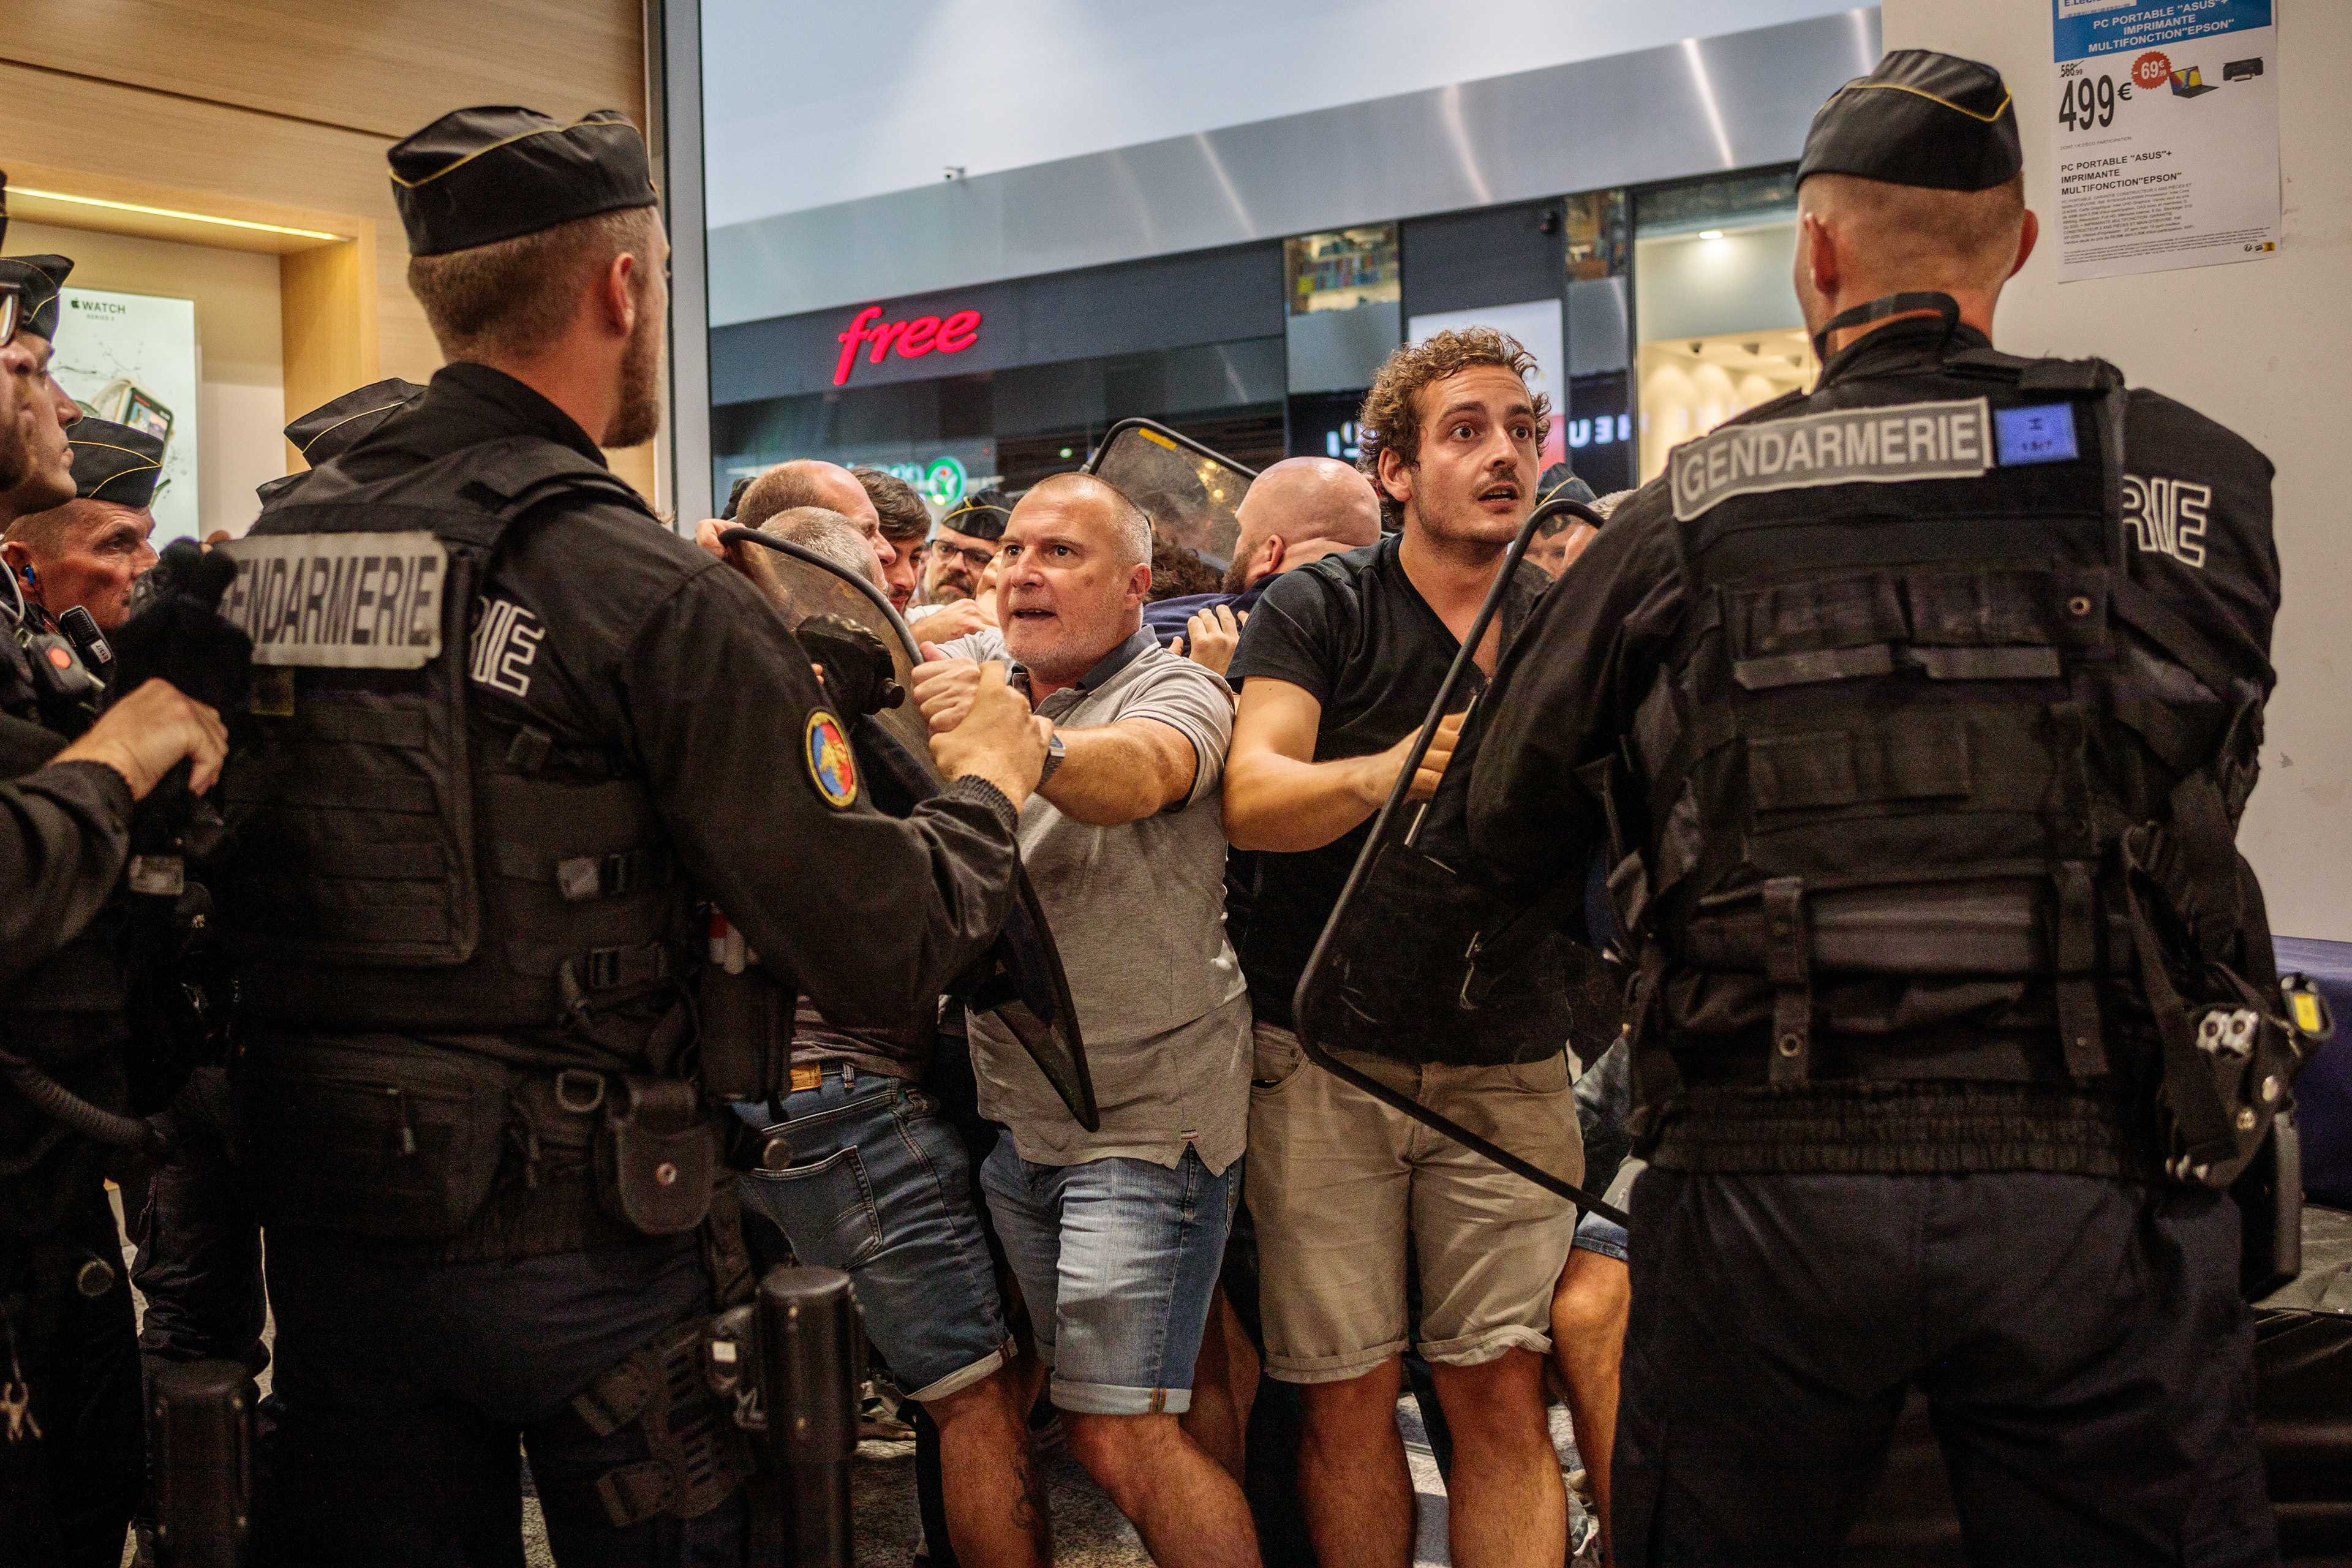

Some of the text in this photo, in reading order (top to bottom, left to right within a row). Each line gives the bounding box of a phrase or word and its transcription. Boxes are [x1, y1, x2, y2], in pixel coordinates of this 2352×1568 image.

[2094, 19, 2109, 29] PC
[2113, 7, 2174, 26] PORTABLE
[2124, 14, 2196, 36] IMPRIMANTE
[2097, 136, 2132, 145] PARTICIPATION
[2076, 156, 2128, 170] PORTABLE
[2062, 169, 2120, 184] IMPRIMANTE
[81, 300, 126, 314] WATCH
[833, 306, 982, 386] free
[1679, 413, 1979, 503] GENDARMERIE
[222, 555, 438, 646] ENDARMERIE
